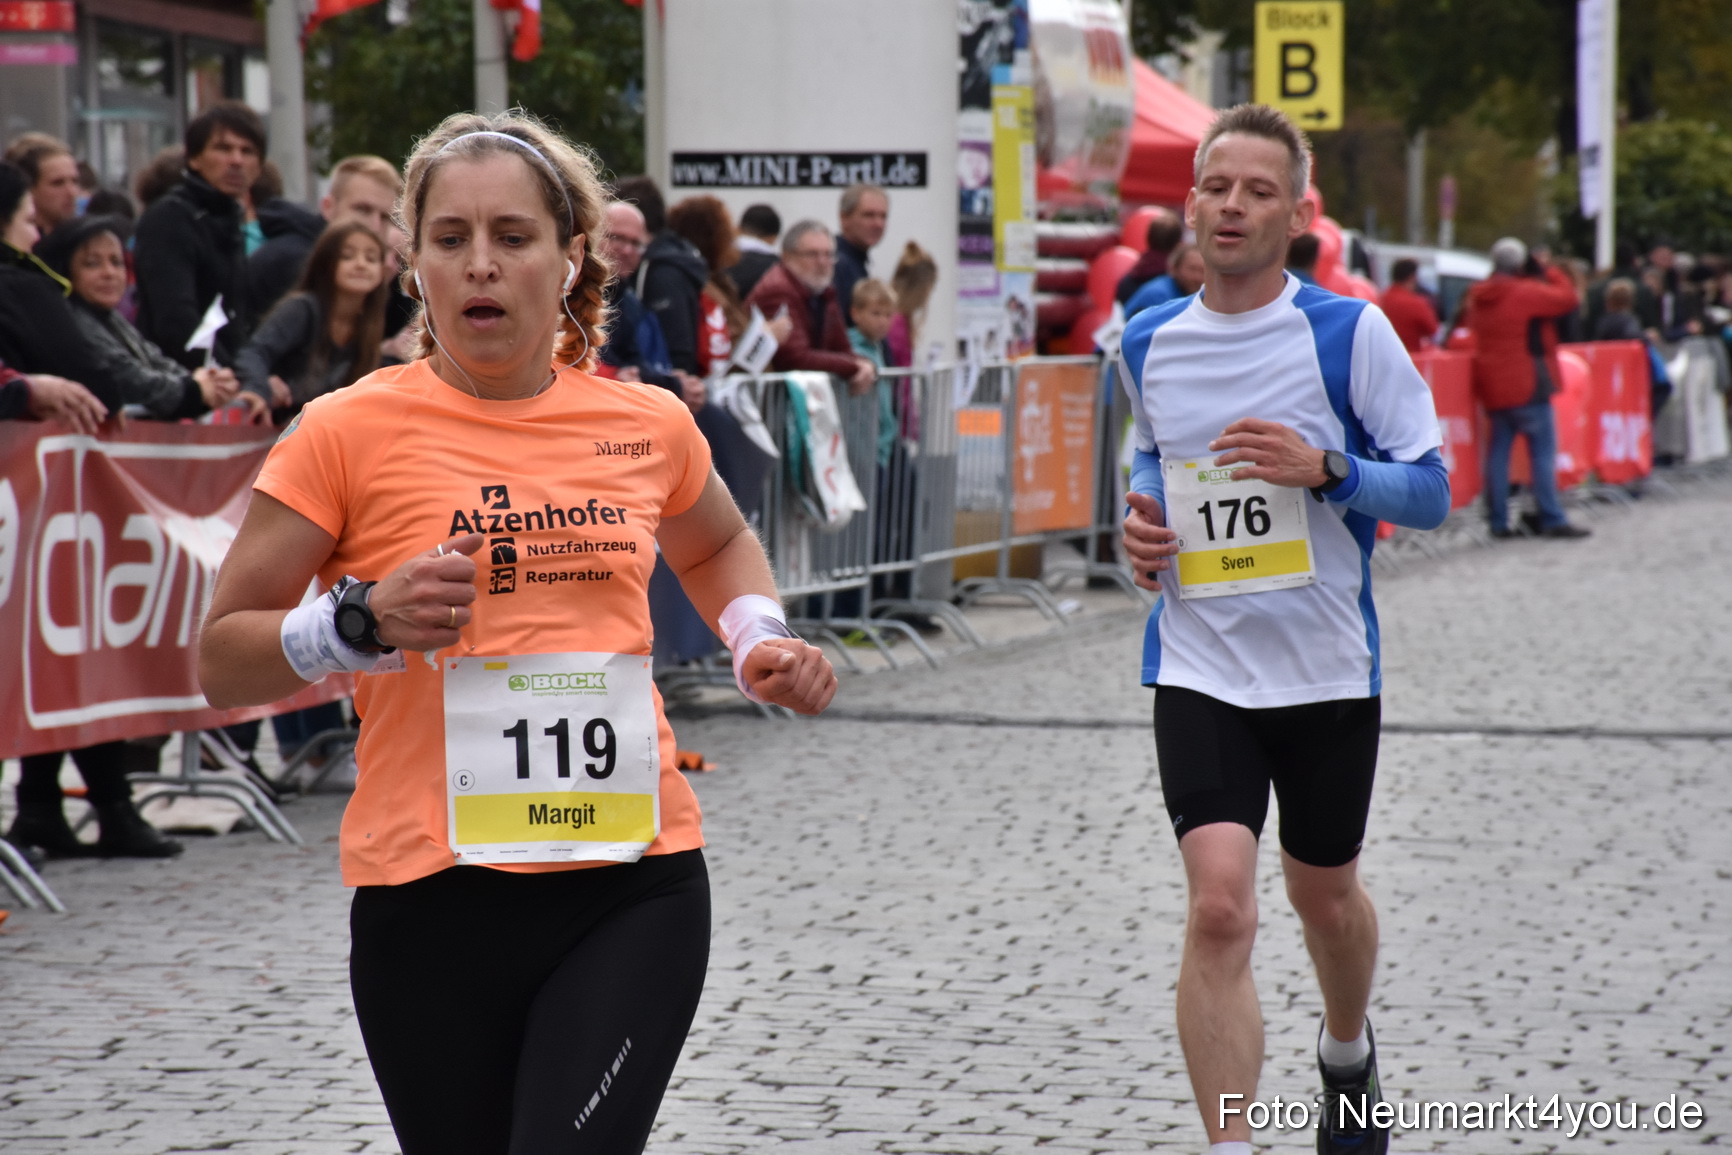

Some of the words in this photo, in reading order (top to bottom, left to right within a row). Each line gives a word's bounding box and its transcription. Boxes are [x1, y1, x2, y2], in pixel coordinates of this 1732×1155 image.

[1267, 7, 1329, 30] Block
[1280, 42, 1318, 98] B
[594, 439, 652, 459] Margit
[449, 499, 627, 537] Atzenhofer
[1197, 496, 1271, 541] 176
[527, 540, 637, 556] Nutzfahrzeug
[1221, 556, 1255, 570] Sven
[526, 569, 613, 584] Reparatur
[532, 673, 606, 690] BOCK
[503, 718, 617, 780] 119
[460, 775, 468, 786] C
[528, 804, 596, 829] Margit
